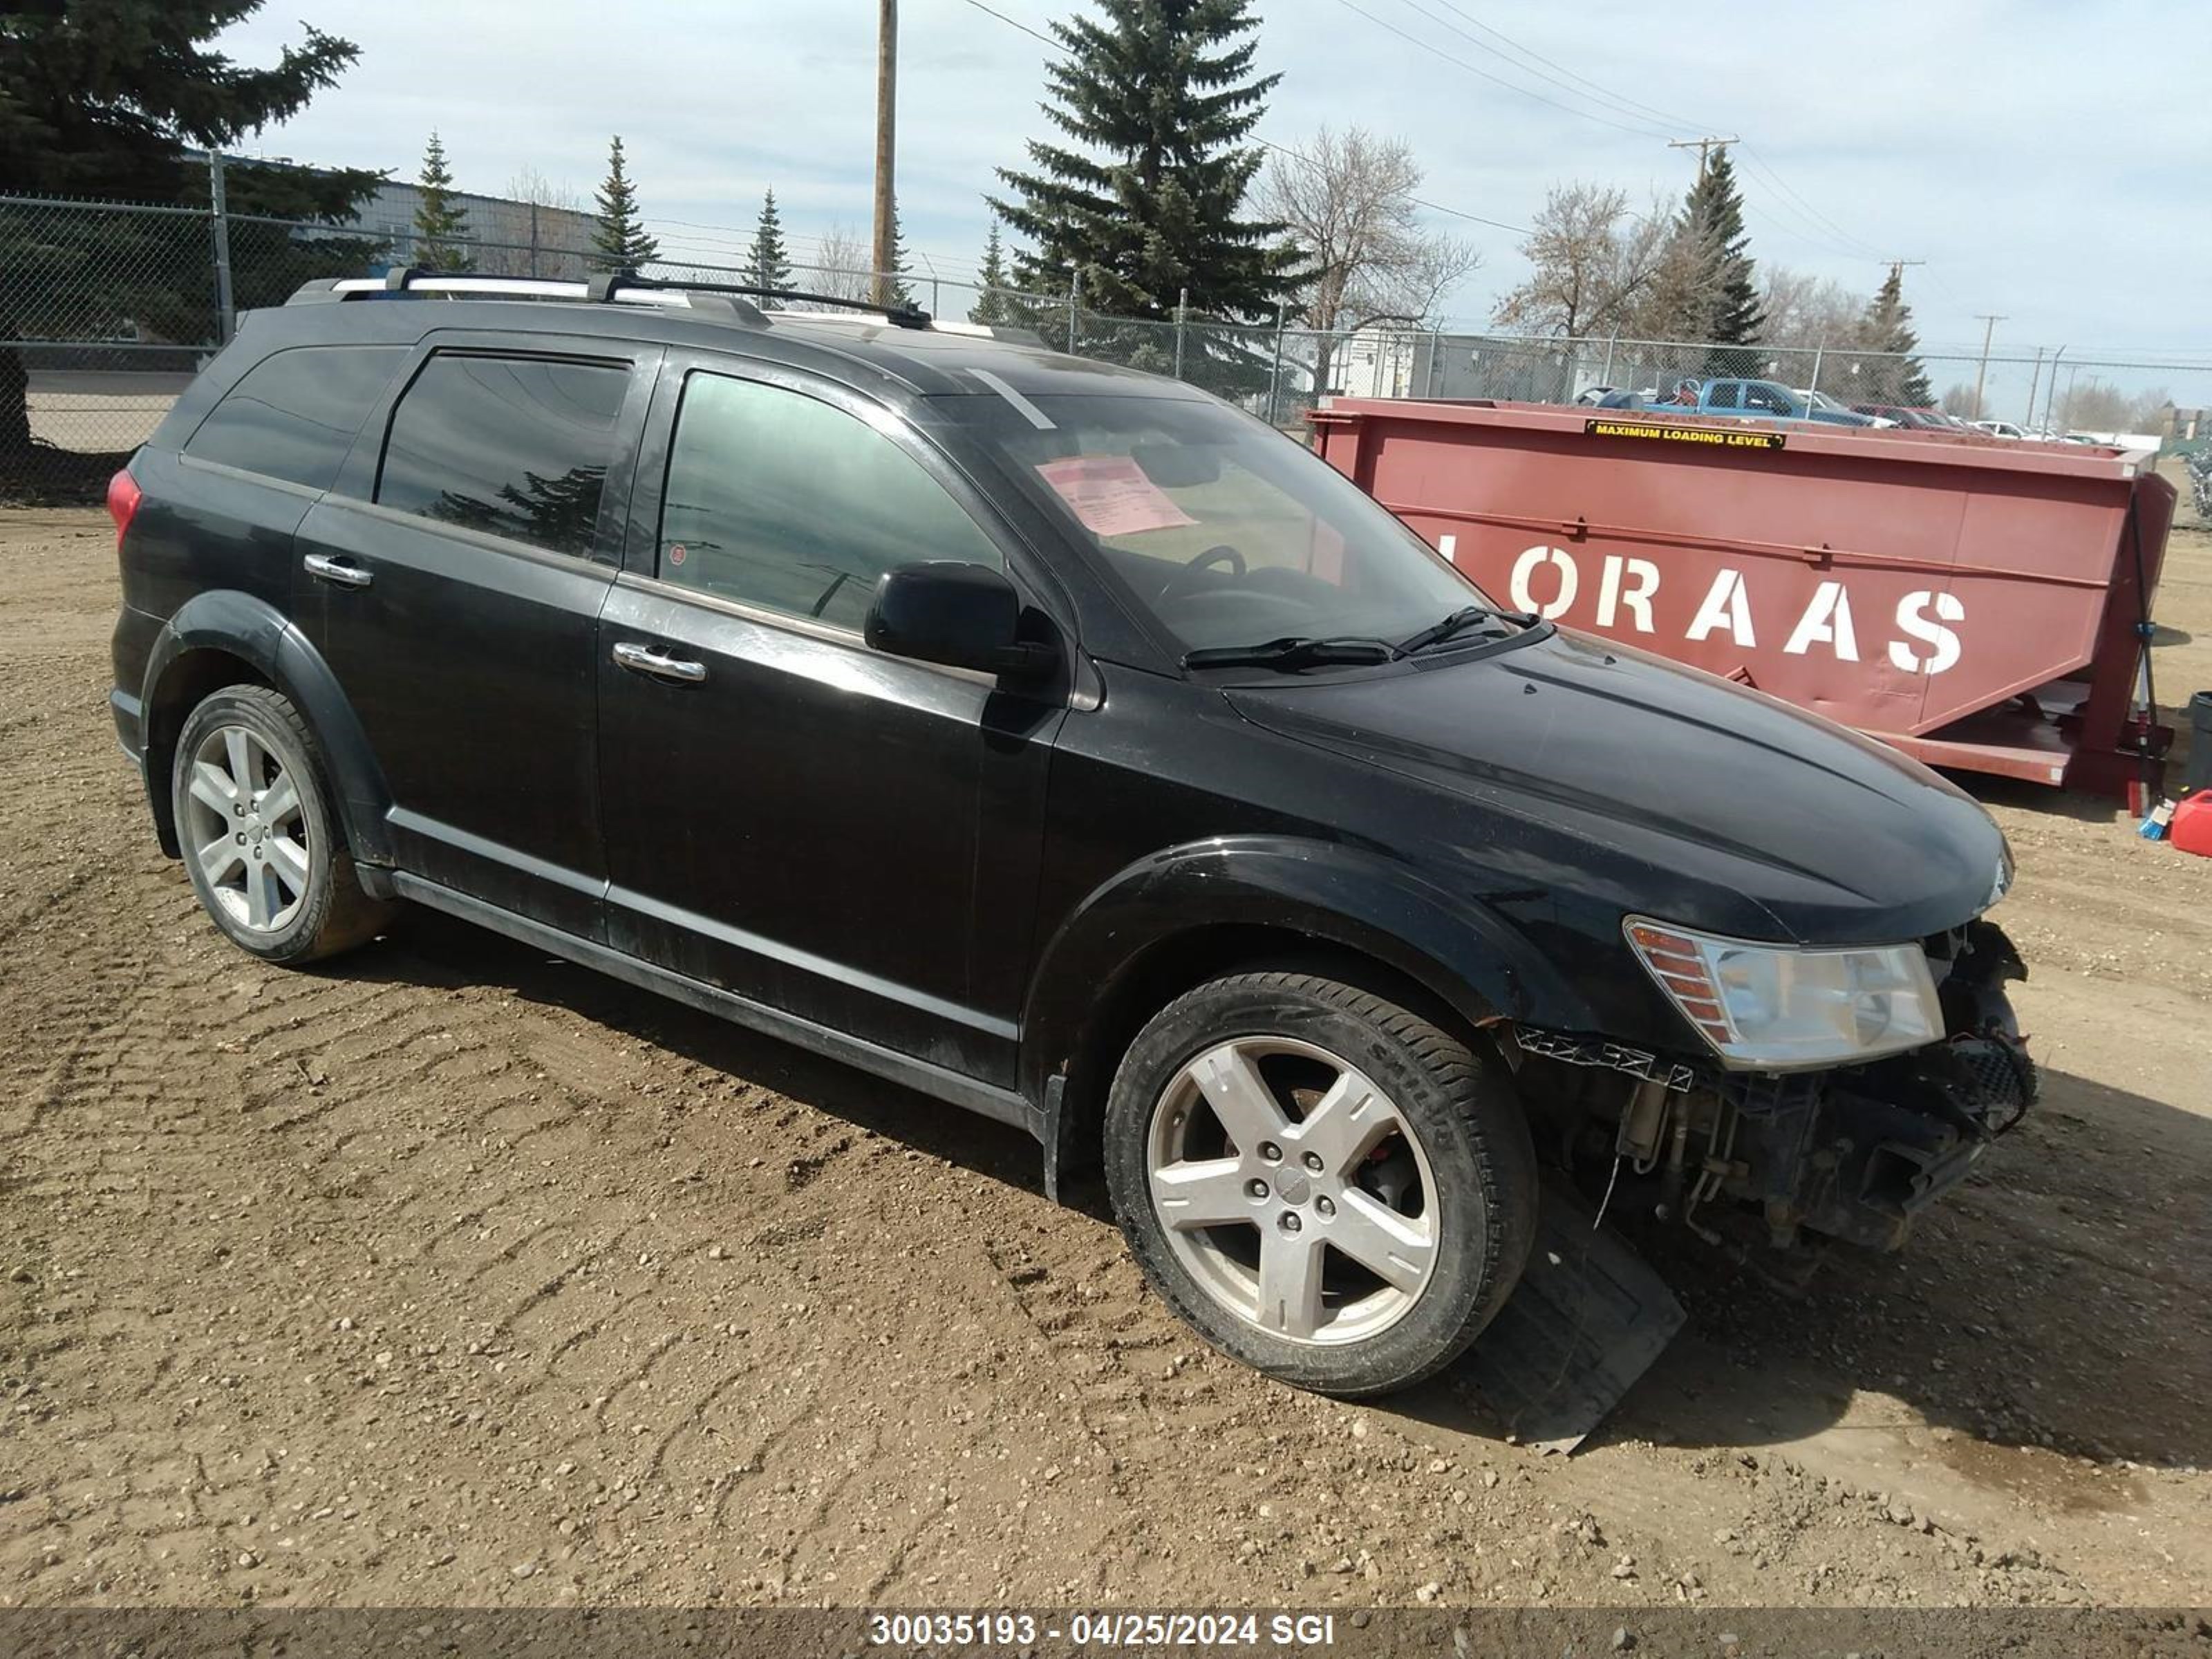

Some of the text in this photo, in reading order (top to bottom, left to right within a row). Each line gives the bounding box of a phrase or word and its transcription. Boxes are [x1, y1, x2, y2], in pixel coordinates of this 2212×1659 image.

[1596, 424, 1771, 447] MAXIMUM LOADING LEVEL
[1438, 535, 1965, 675] ORAAS
